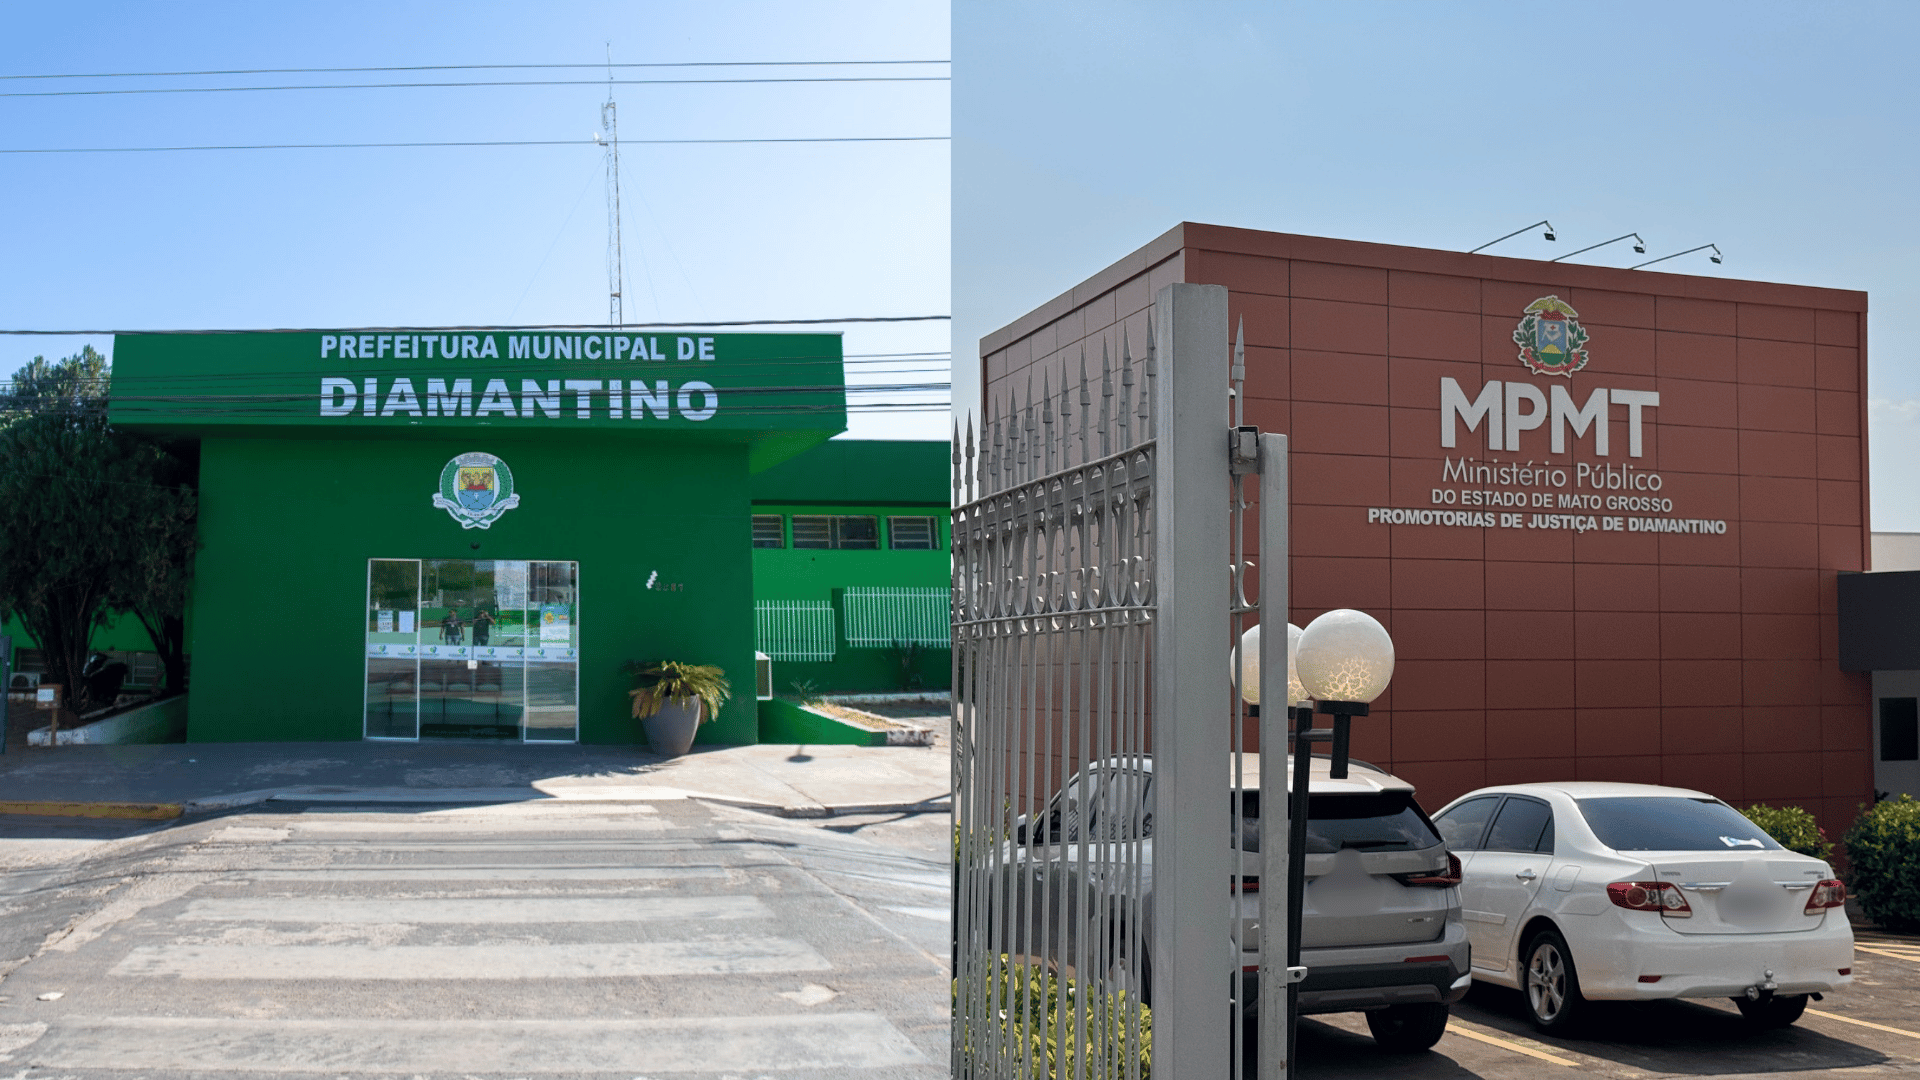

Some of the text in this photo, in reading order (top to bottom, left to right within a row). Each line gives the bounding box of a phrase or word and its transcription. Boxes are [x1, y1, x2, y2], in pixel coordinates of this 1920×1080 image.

[321, 335, 716, 361] PREFEITURA MUNICIPAL DE
[320, 377, 719, 422] DIAMANTINO
[1441, 376, 1661, 458] MPMT
[1442, 455, 1663, 491] Ministério Público
[1432, 488, 1674, 513] DO ESTADO DE MATO GROSSO
[1368, 508, 1727, 535] PROMOTORIAS DE JUSTIÇA DE DIAMANTINO
